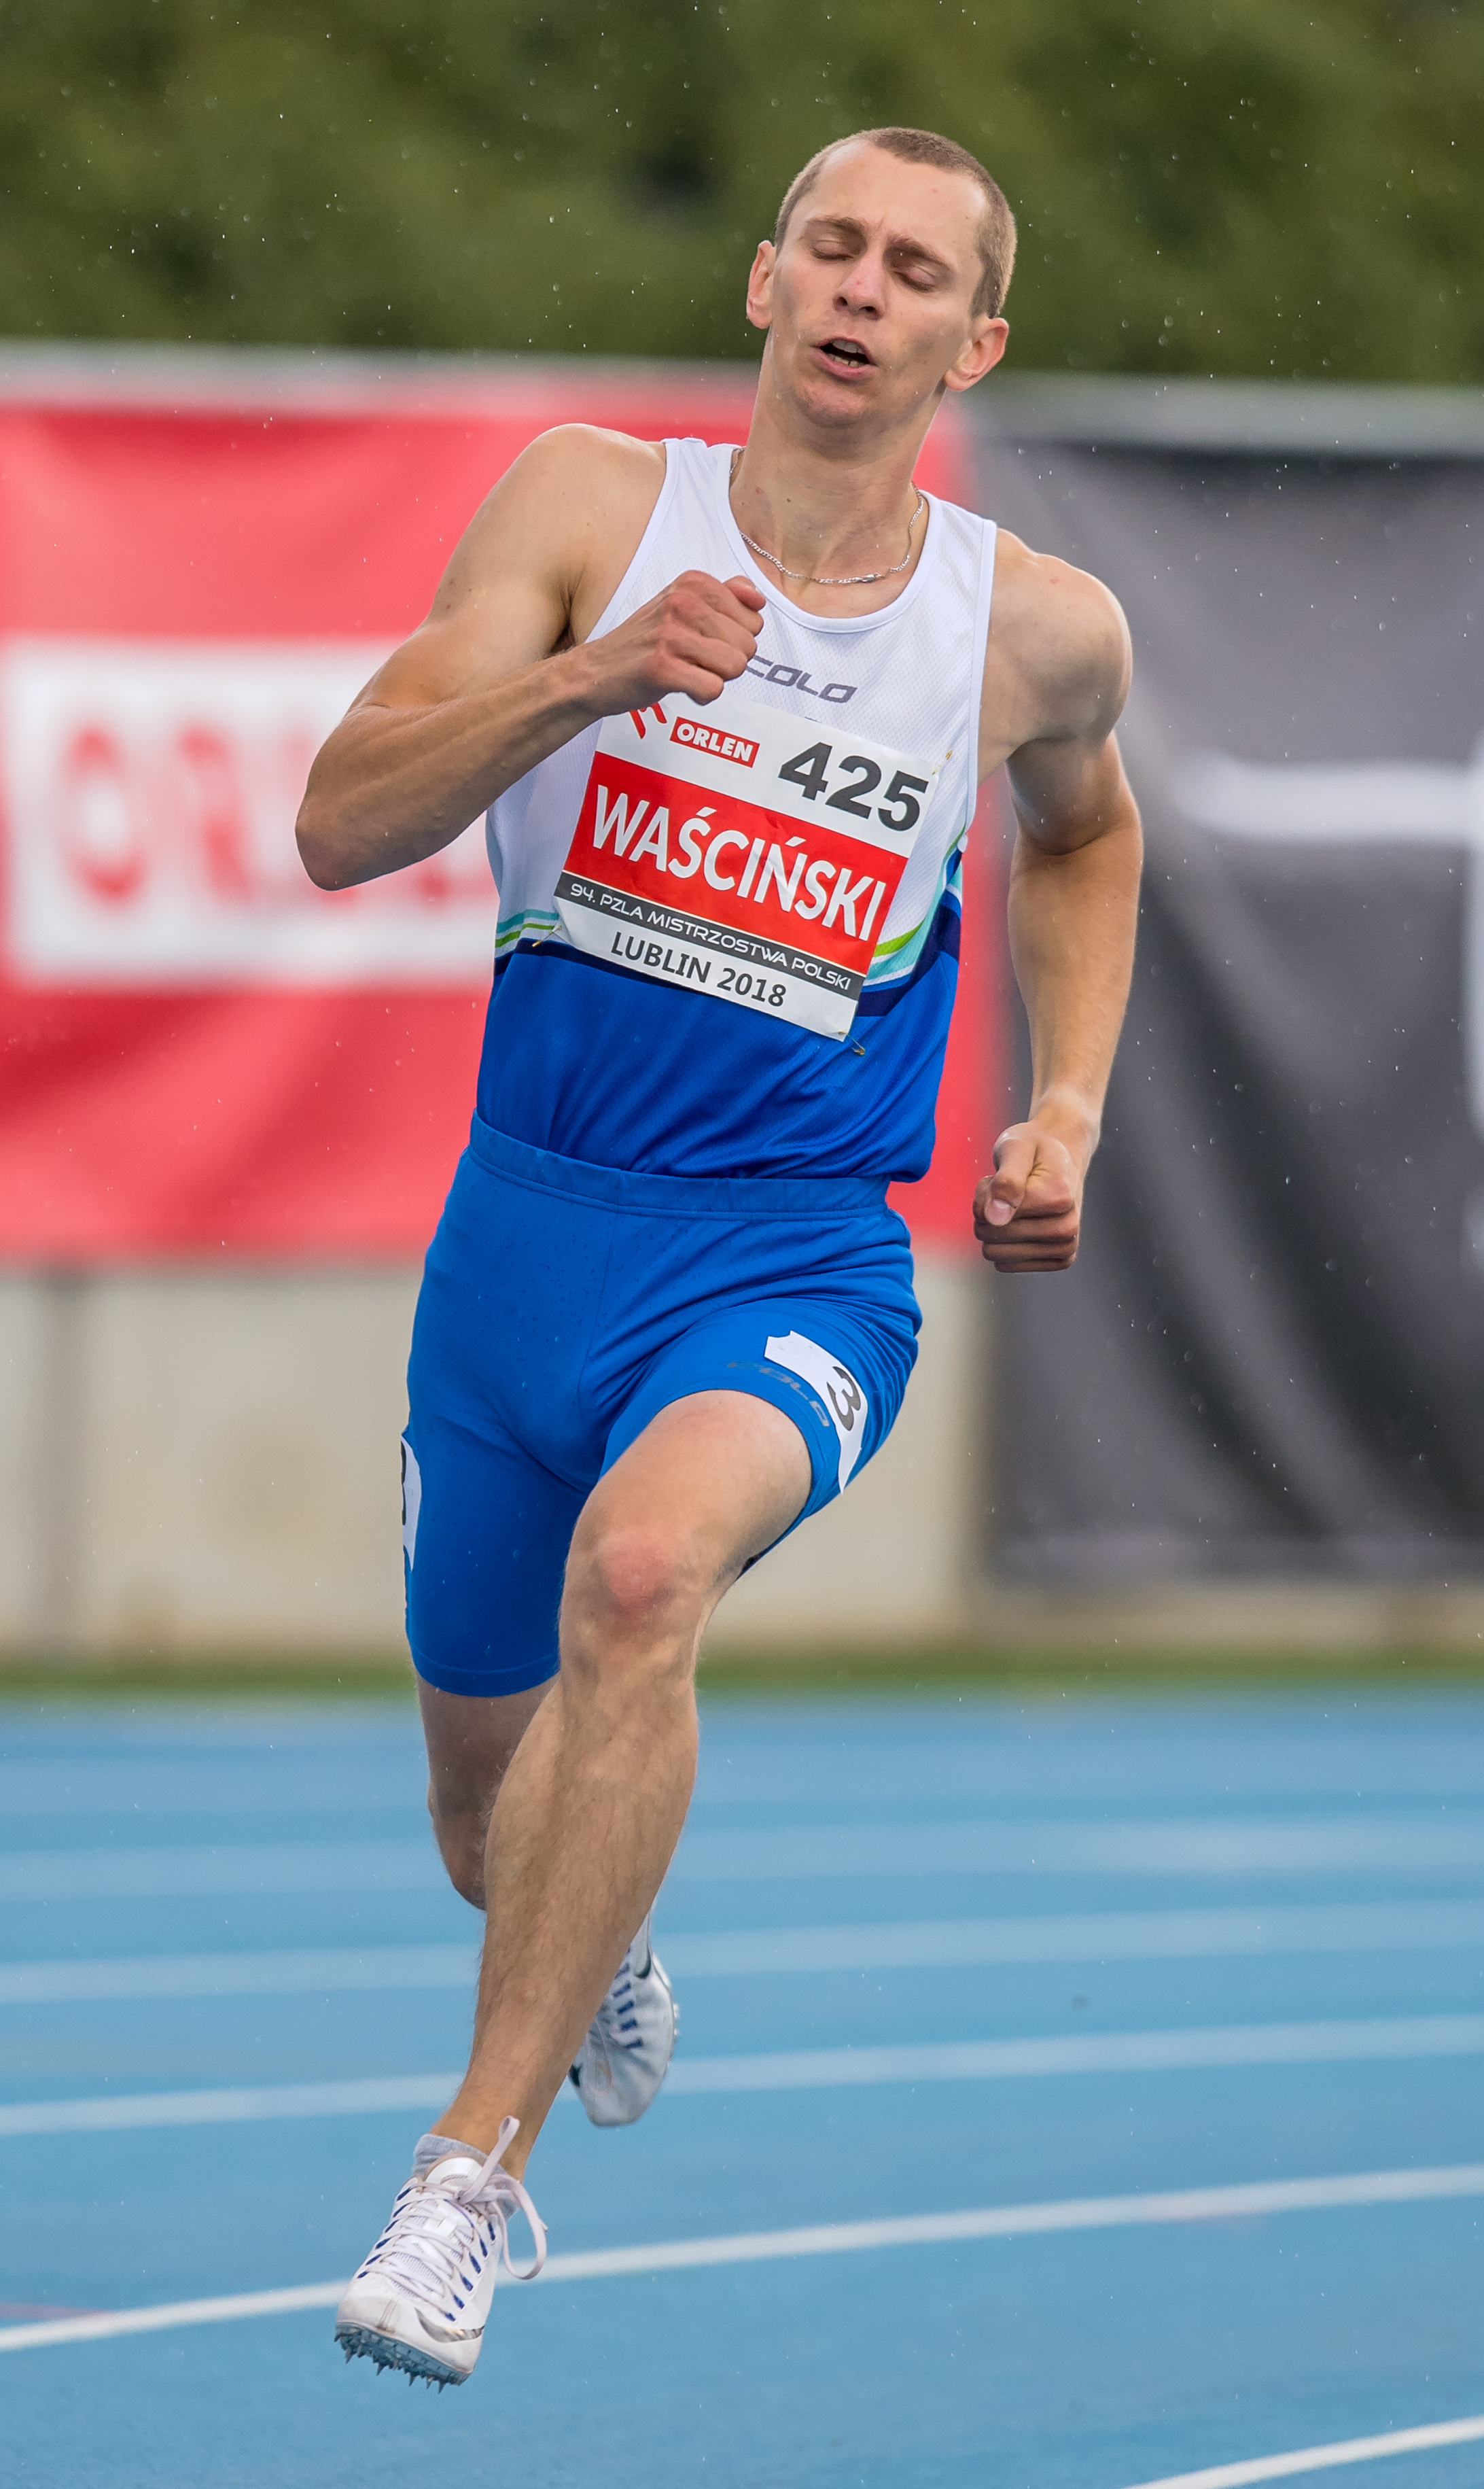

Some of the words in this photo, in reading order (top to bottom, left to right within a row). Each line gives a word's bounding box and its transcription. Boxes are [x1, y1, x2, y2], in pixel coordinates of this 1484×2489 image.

[677, 723, 754, 762] ORLEN
[778, 742, 930, 831] 425
[593, 785, 886, 941] WAŚCIŃSKI
[570, 883, 596, 903] 94.
[599, 893, 643, 920] PZLA
[647, 911, 788, 967] MISTRZOSTWA
[791, 957, 851, 990] POLSKI
[611, 931, 711, 984] LUBLIN
[716, 968, 786, 1007] 2018
[826, 1365, 862, 1431] 3
